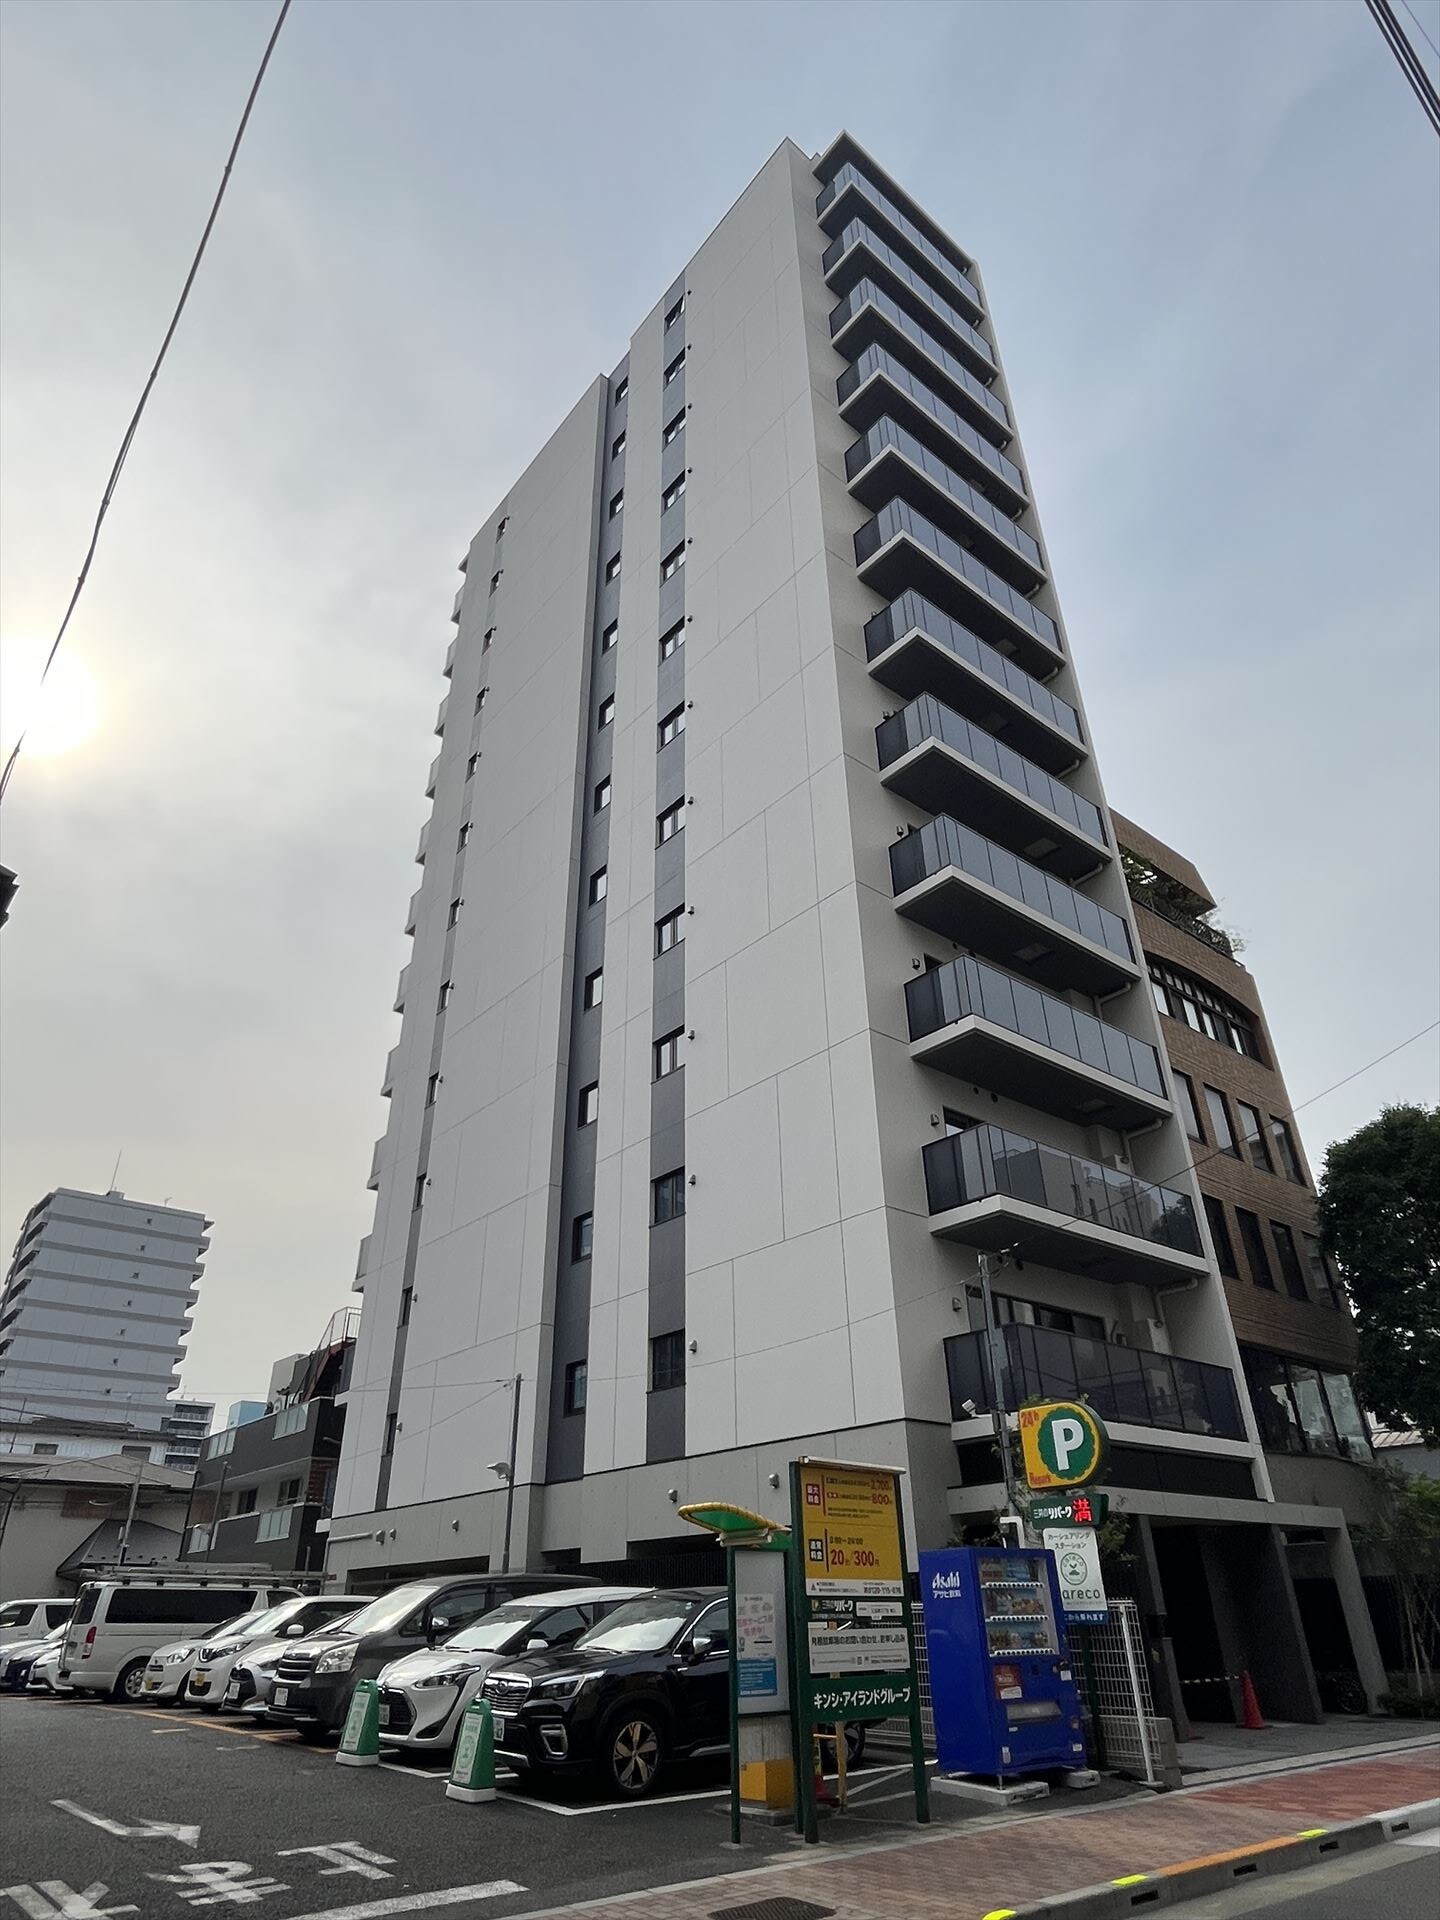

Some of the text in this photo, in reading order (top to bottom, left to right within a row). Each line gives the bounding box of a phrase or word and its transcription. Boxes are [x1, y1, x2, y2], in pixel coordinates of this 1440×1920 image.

[1052, 1419, 1084, 1471] P
[1072, 1498, 1092, 1522] 満
[1047, 1531, 1090, 1542] カーシェアリング
[1055, 1543, 1087, 1551] ステーション
[932, 1571, 960, 1588] Asahi
[813, 1686, 911, 1709] キンシ・アイランドグループ
